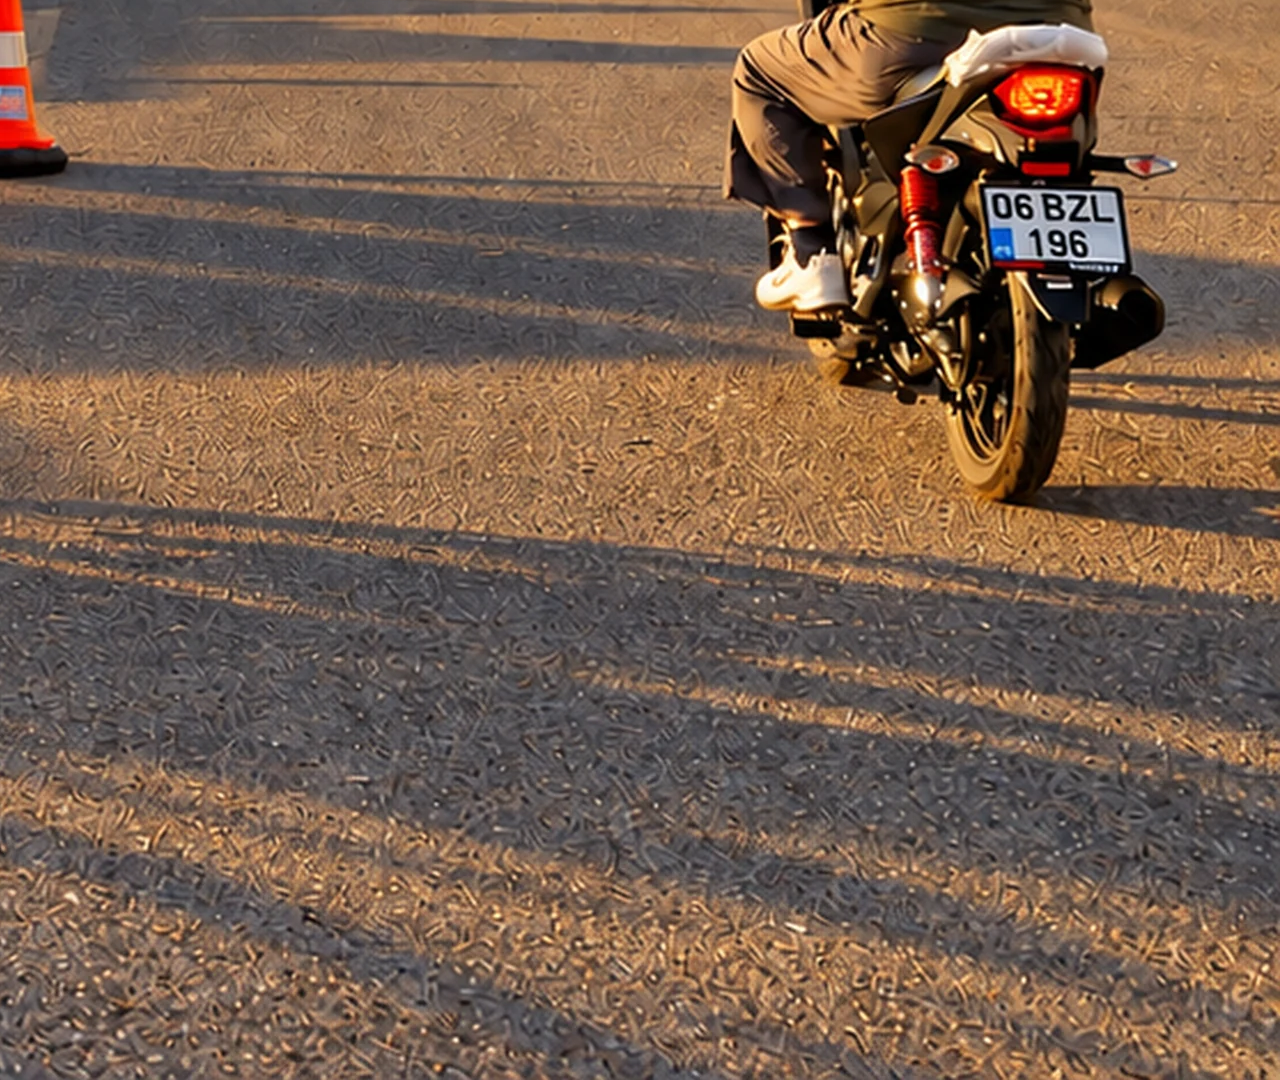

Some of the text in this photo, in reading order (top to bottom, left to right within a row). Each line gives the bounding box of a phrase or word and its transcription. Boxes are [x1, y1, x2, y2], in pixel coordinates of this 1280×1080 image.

[992, 193, 1114, 223] 06 BZL
[1029, 229, 1088, 258] 196
